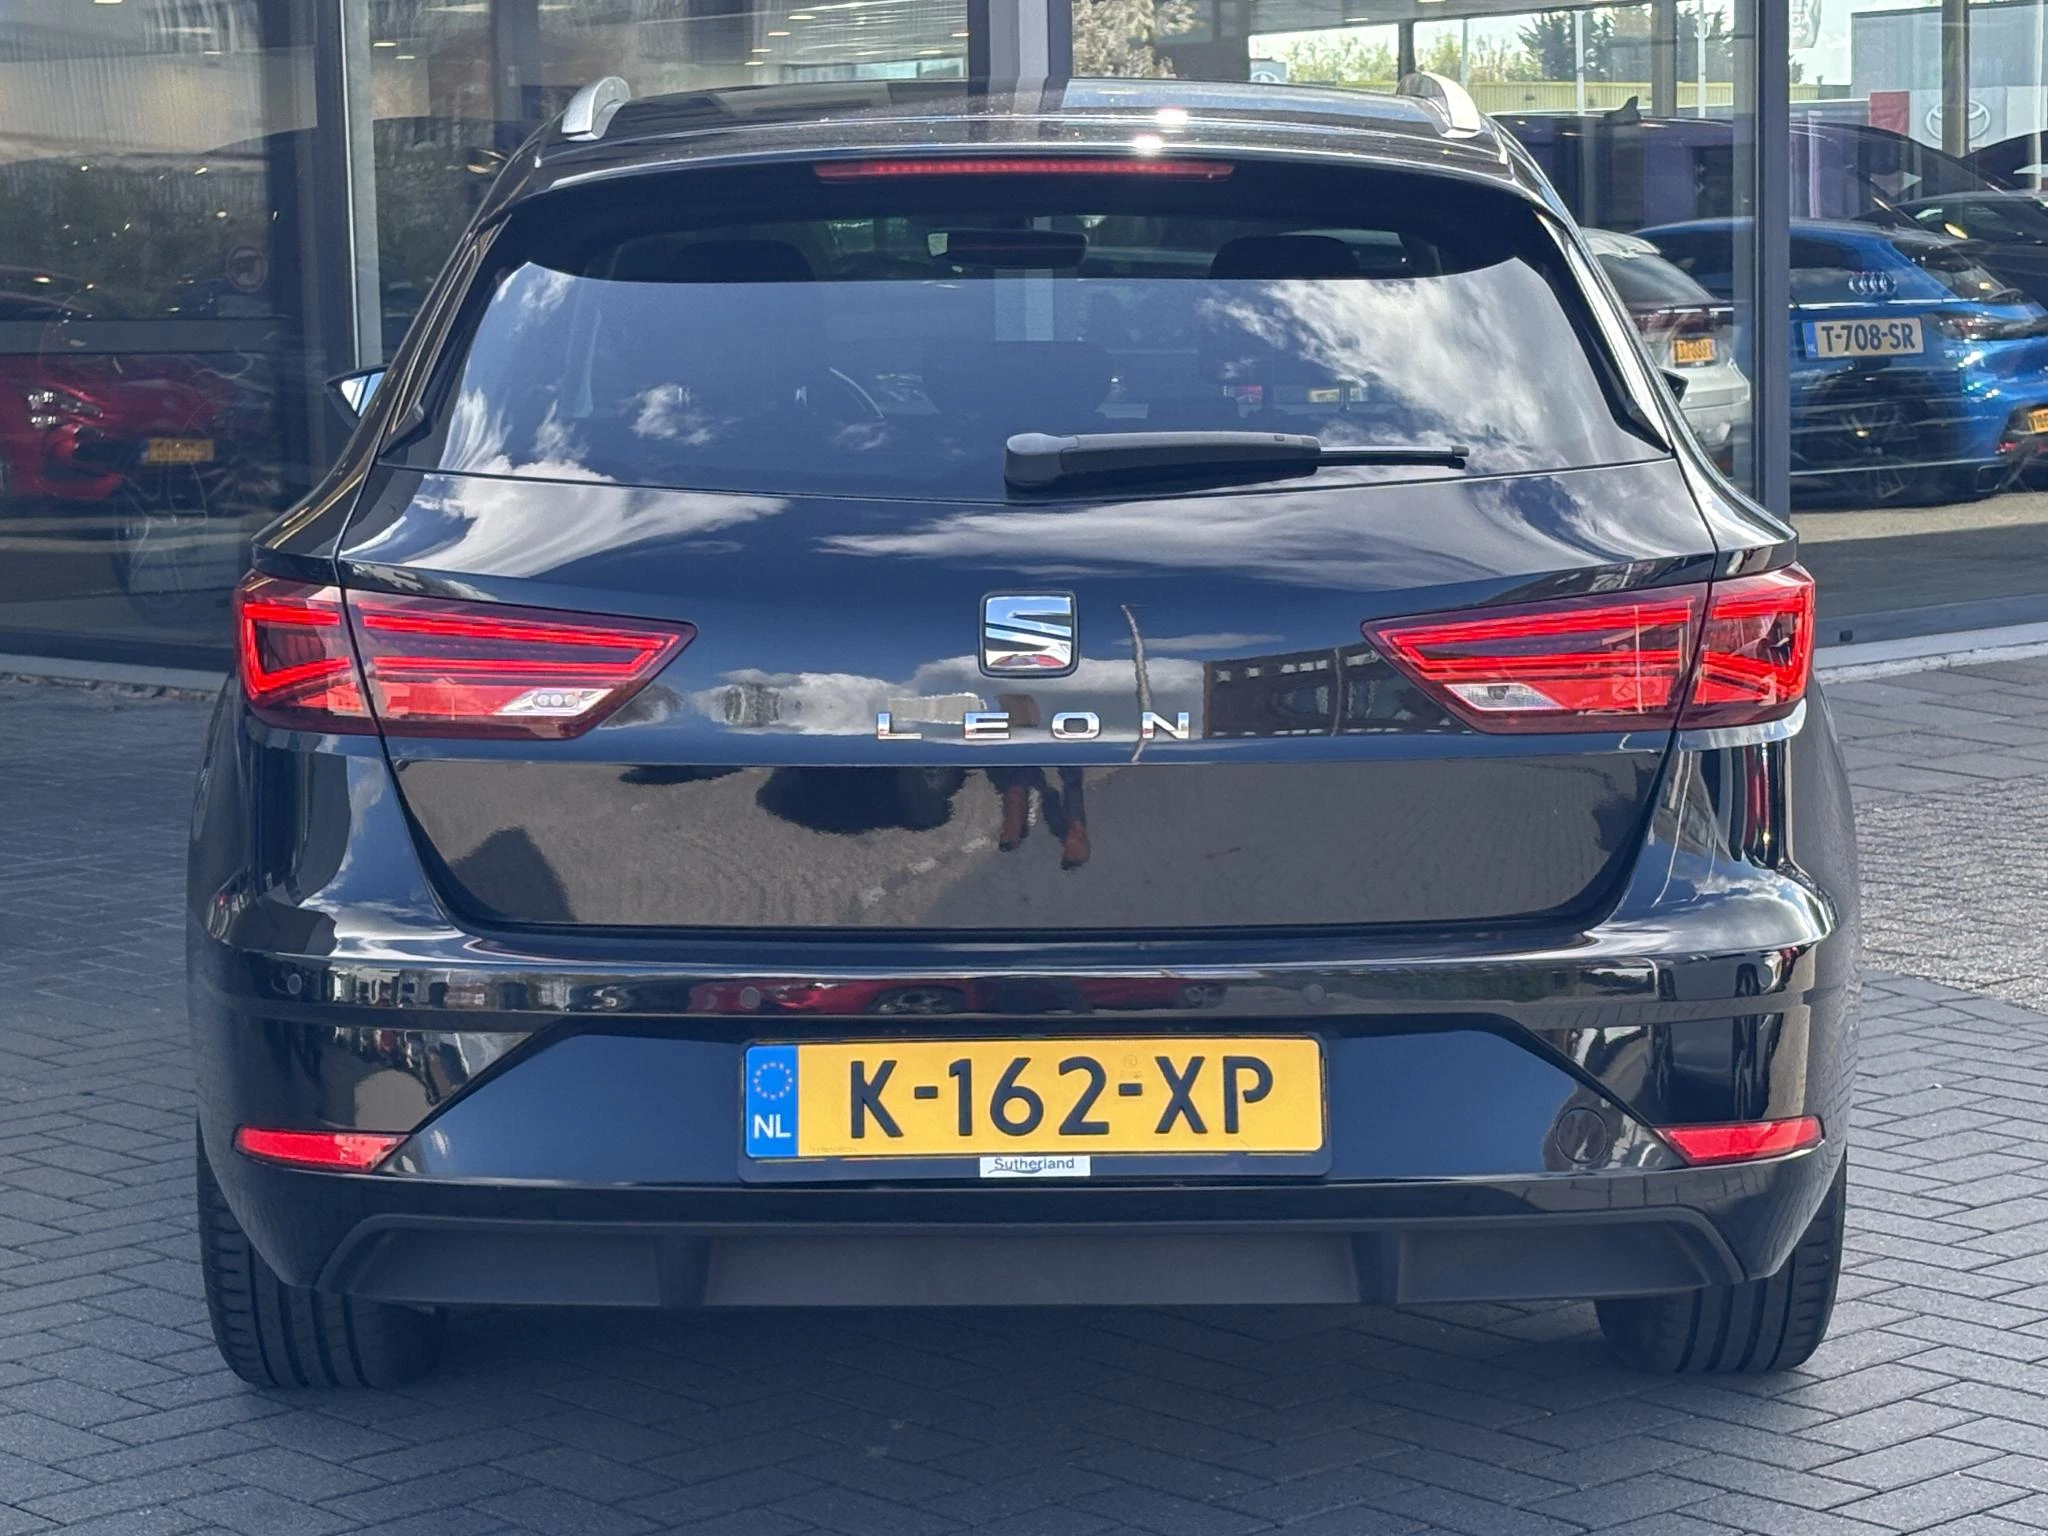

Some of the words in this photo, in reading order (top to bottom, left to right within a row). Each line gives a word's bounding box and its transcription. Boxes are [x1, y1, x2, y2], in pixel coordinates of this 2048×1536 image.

[1821, 323, 1915, 352] T-708-SR
[877, 712, 1190, 740] LEON
[850, 1055, 1274, 1139] K-162-XP
[753, 1114, 791, 1139] NL
[994, 1158, 1075, 1171] Sutherland
